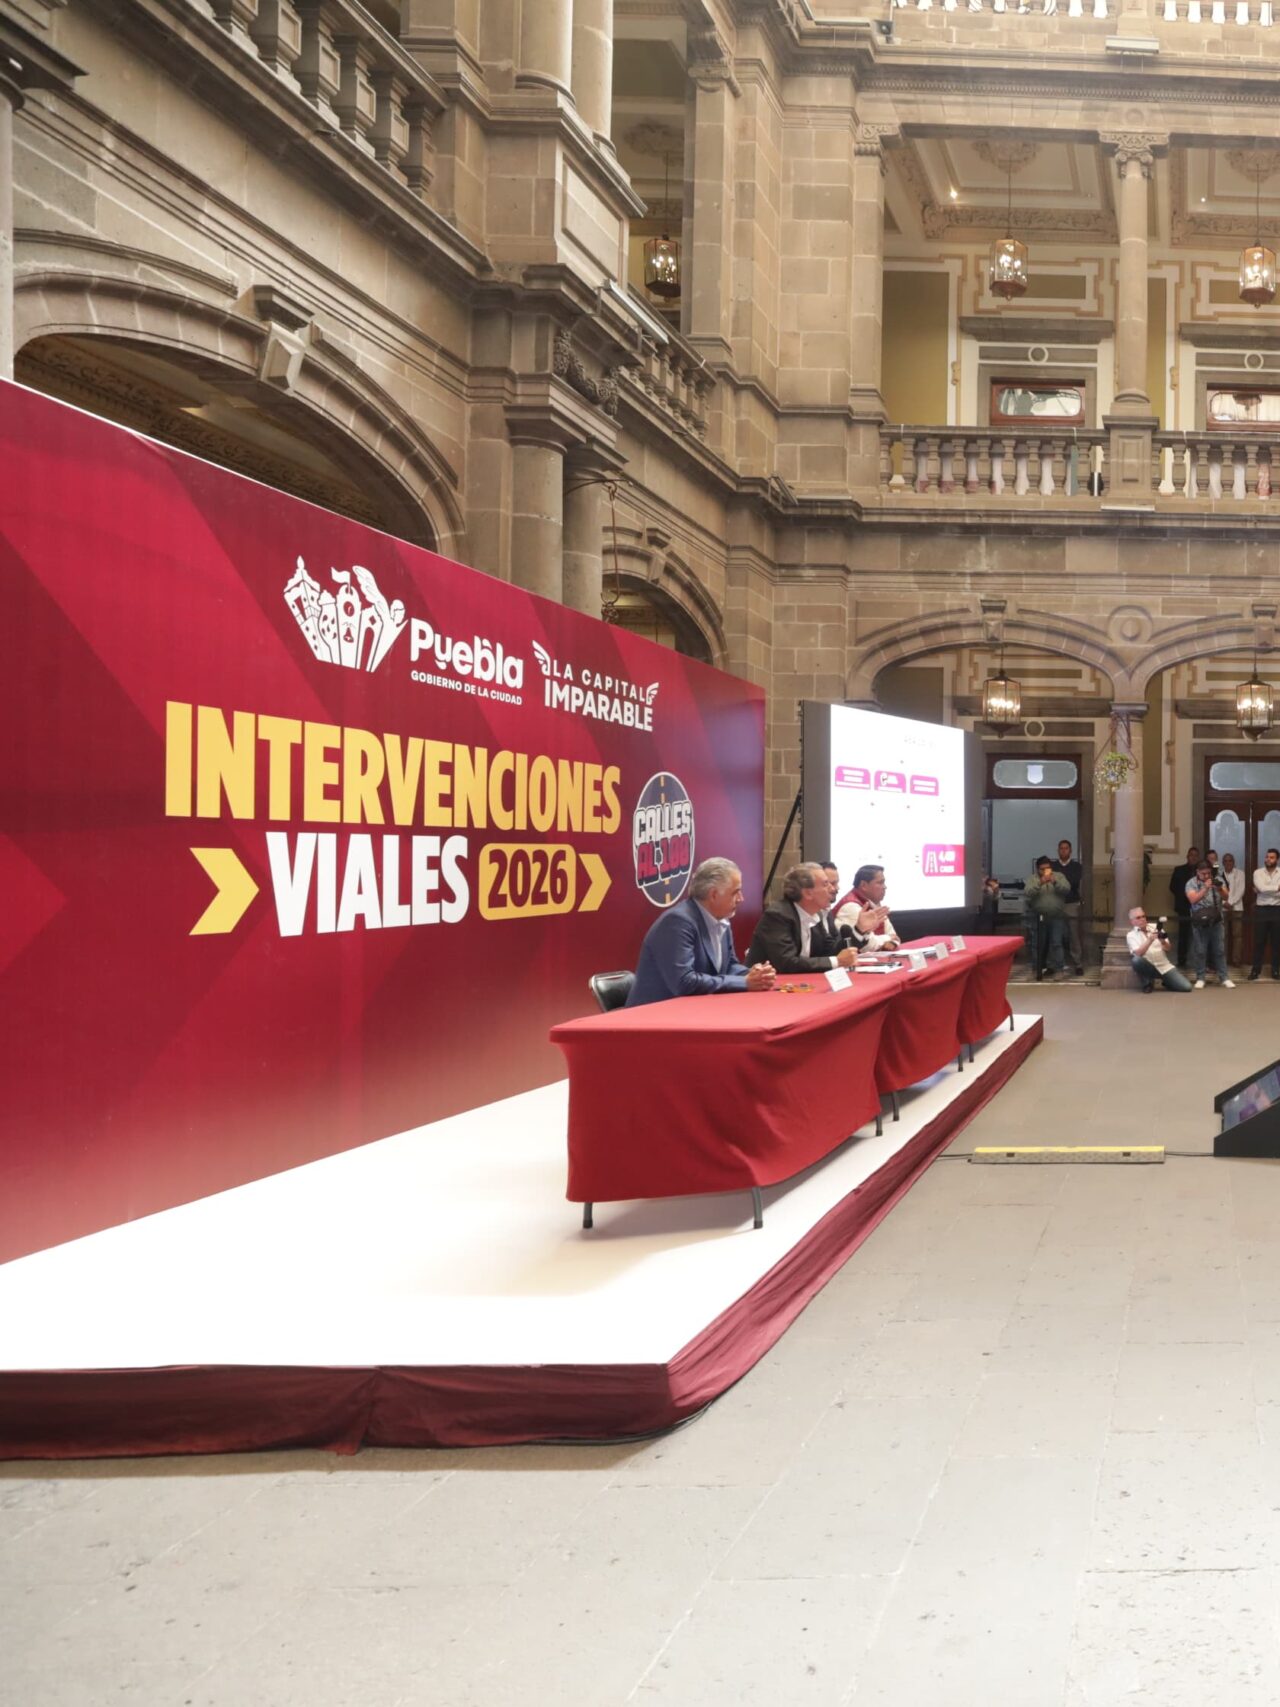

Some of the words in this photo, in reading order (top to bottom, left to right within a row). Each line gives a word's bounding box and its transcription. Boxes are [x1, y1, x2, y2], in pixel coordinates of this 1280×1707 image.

[410, 617, 523, 689] Puebla
[411, 670, 462, 692] GOBIERNO
[464, 682, 476, 695] DE
[477, 685, 489, 698] LA
[490, 689, 523, 705] CIUDAD
[544, 679, 653, 732] IMPARABLE
[553, 659, 574, 681] LA
[581, 669, 647, 702] CAPITAL
[165, 700, 621, 834] INTERVENCIONES
[635, 801, 692, 846] CALLES
[265, 831, 470, 937] VIALES
[487, 848, 569, 909] 2026
